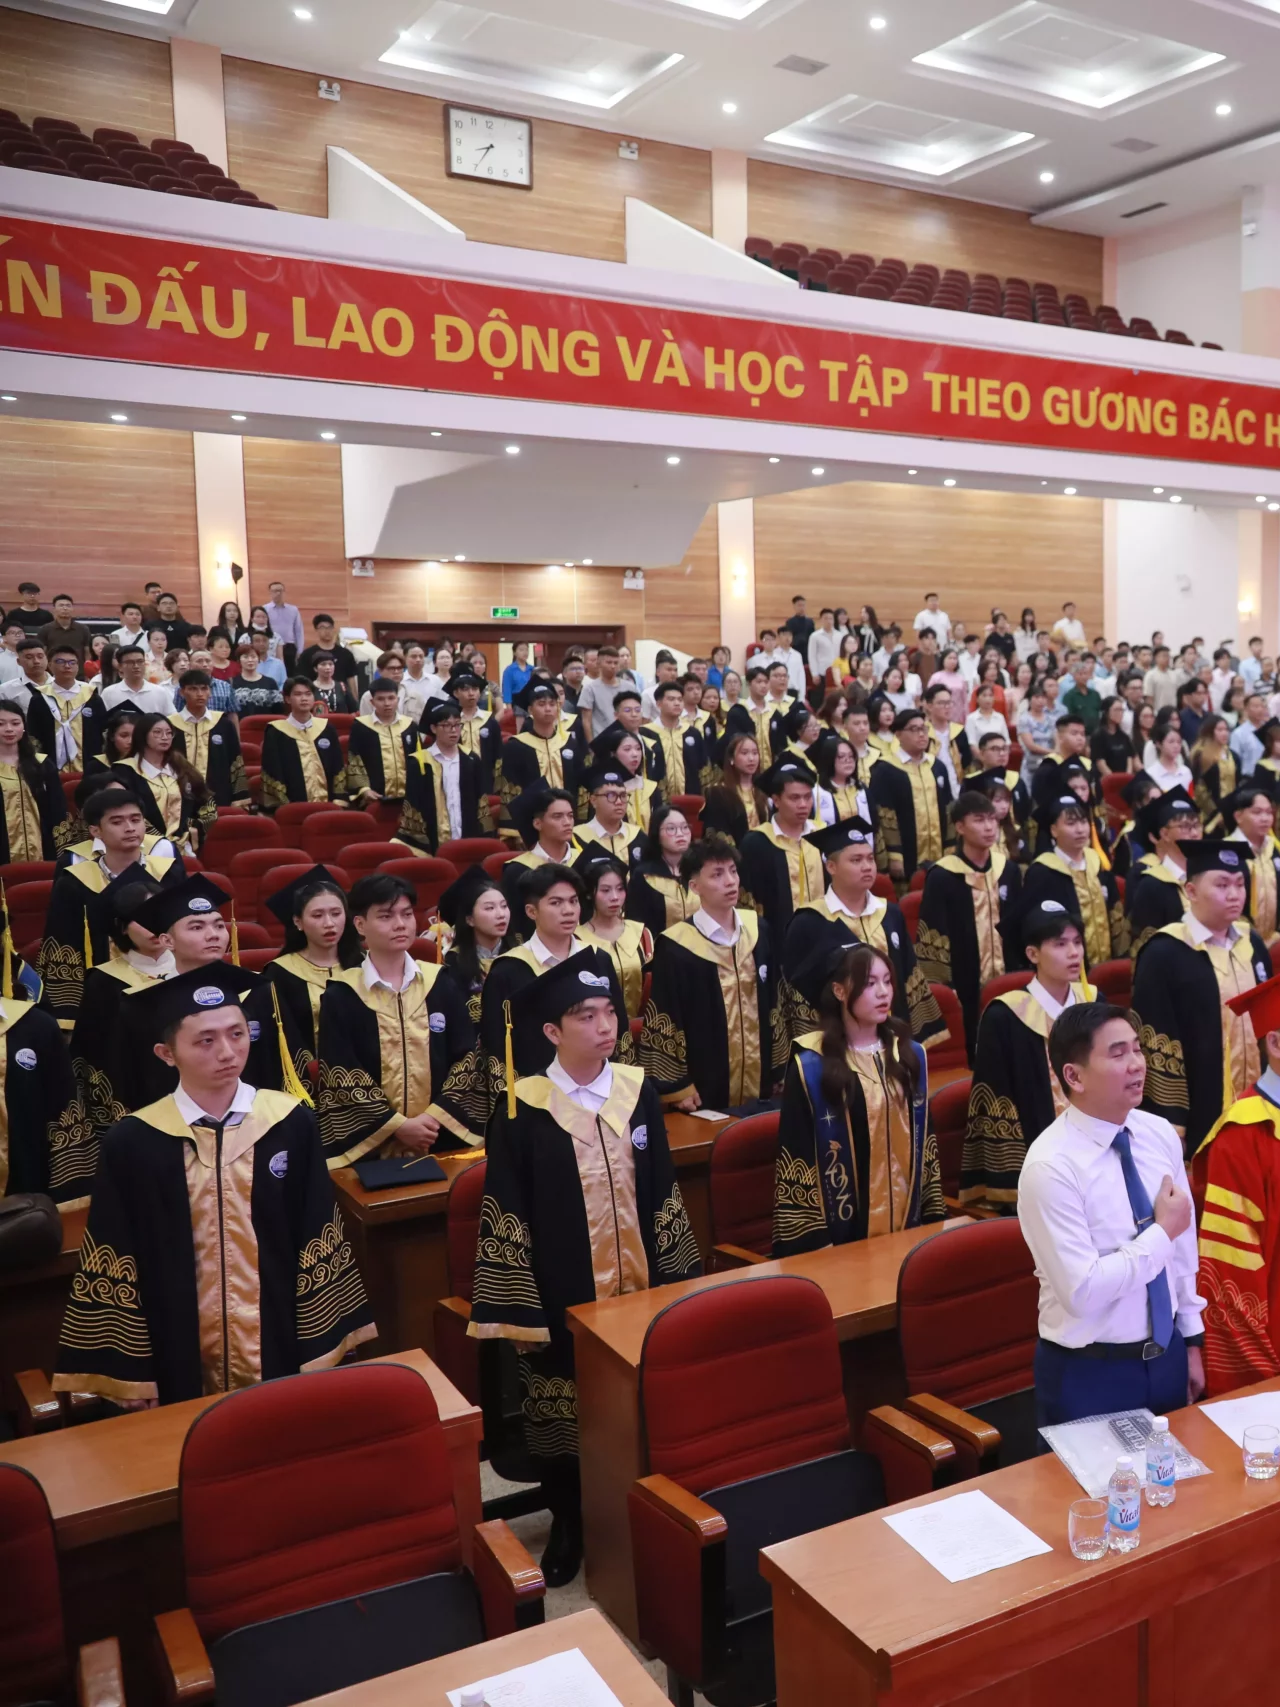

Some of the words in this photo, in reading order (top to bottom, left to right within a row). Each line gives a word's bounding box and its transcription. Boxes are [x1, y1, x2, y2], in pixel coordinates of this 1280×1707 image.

[454, 119, 463, 129] 10
[485, 120, 494, 129] 12
[487, 166, 494, 175] 6
[88, 261, 270, 350] ĐẤU,
[292, 297, 415, 357] LAO
[431, 308, 600, 380] ĐỘNG
[616, 329, 690, 386] VÀ
[704, 346, 805, 407] HỌC
[819, 354, 909, 417] TẬP
[923, 371, 1030, 421] THEO
[1042, 386, 1177, 437] GƯƠNG
[1189, 398, 1256, 446] BÁC
